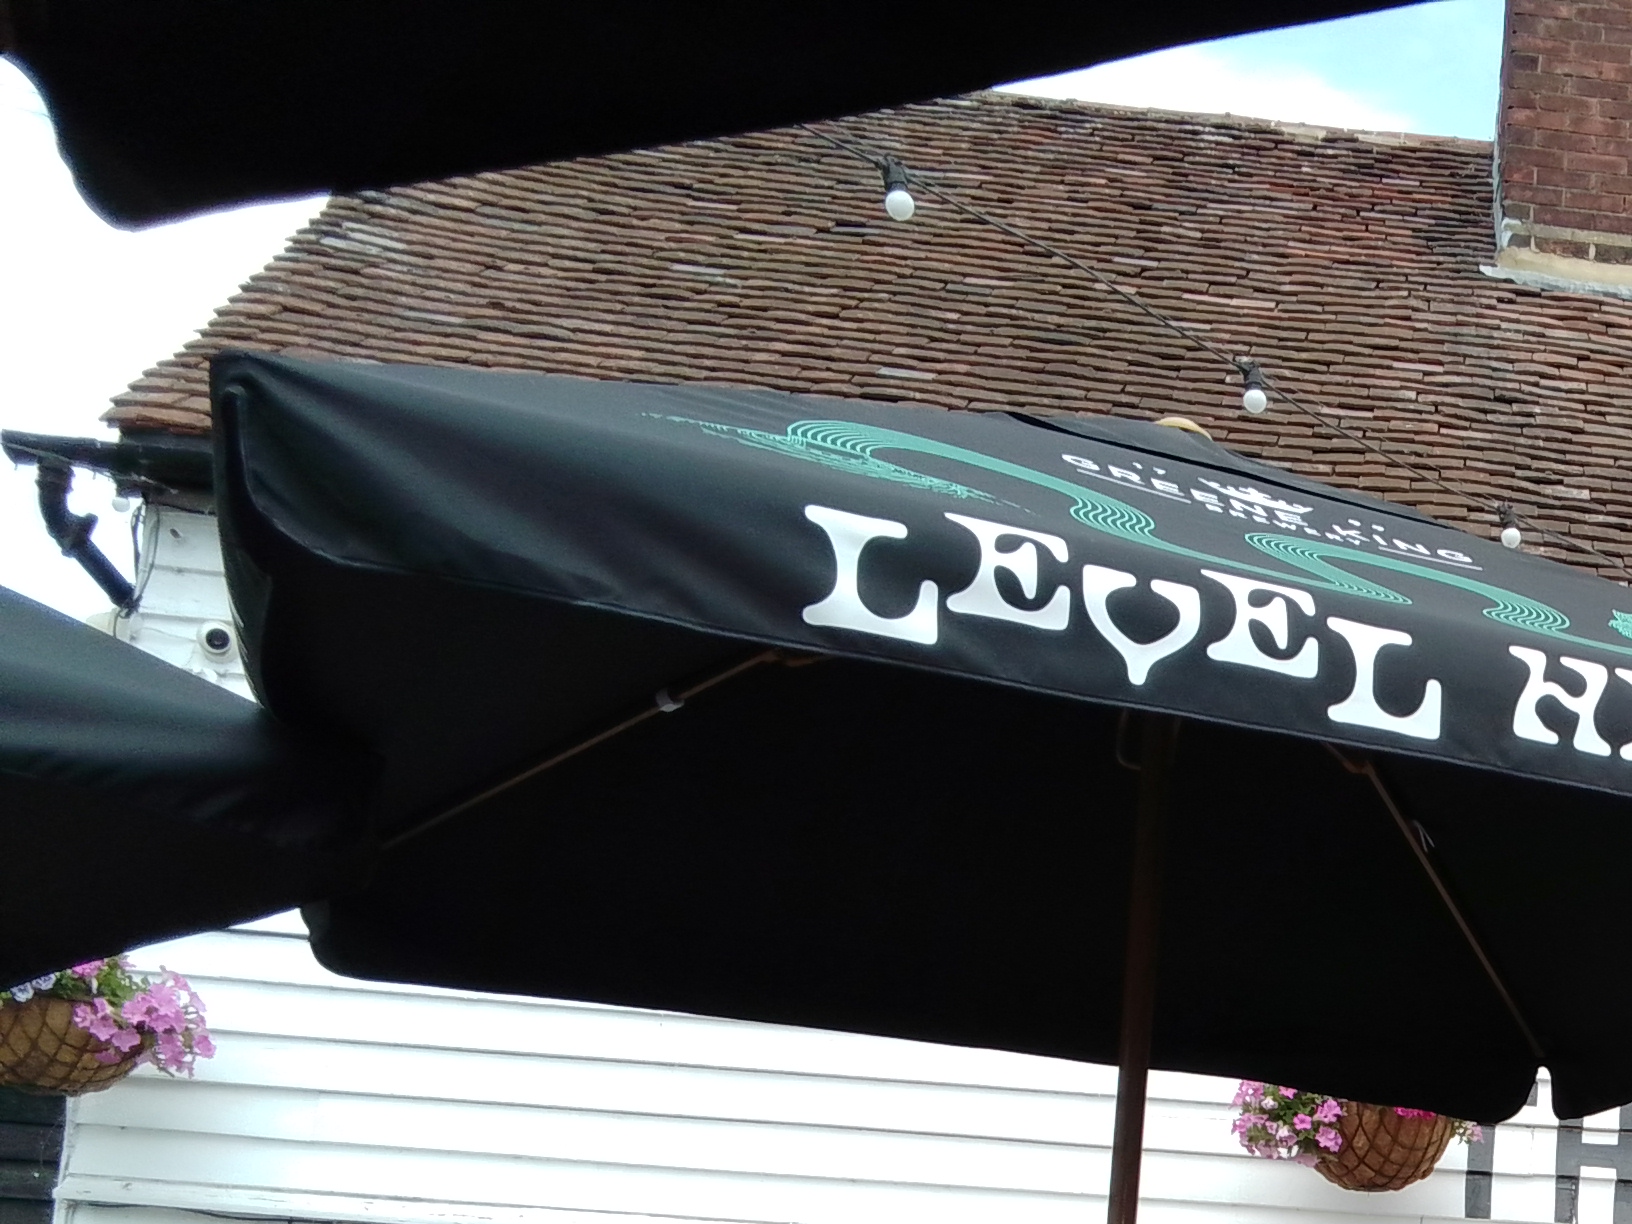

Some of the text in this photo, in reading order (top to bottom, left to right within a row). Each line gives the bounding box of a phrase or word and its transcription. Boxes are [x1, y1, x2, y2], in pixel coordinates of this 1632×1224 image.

[1061, 453, 1473, 564] GREENE KING
[1204, 503, 1362, 547] BREWERY
[802, 503, 1442, 741] LEVEL
